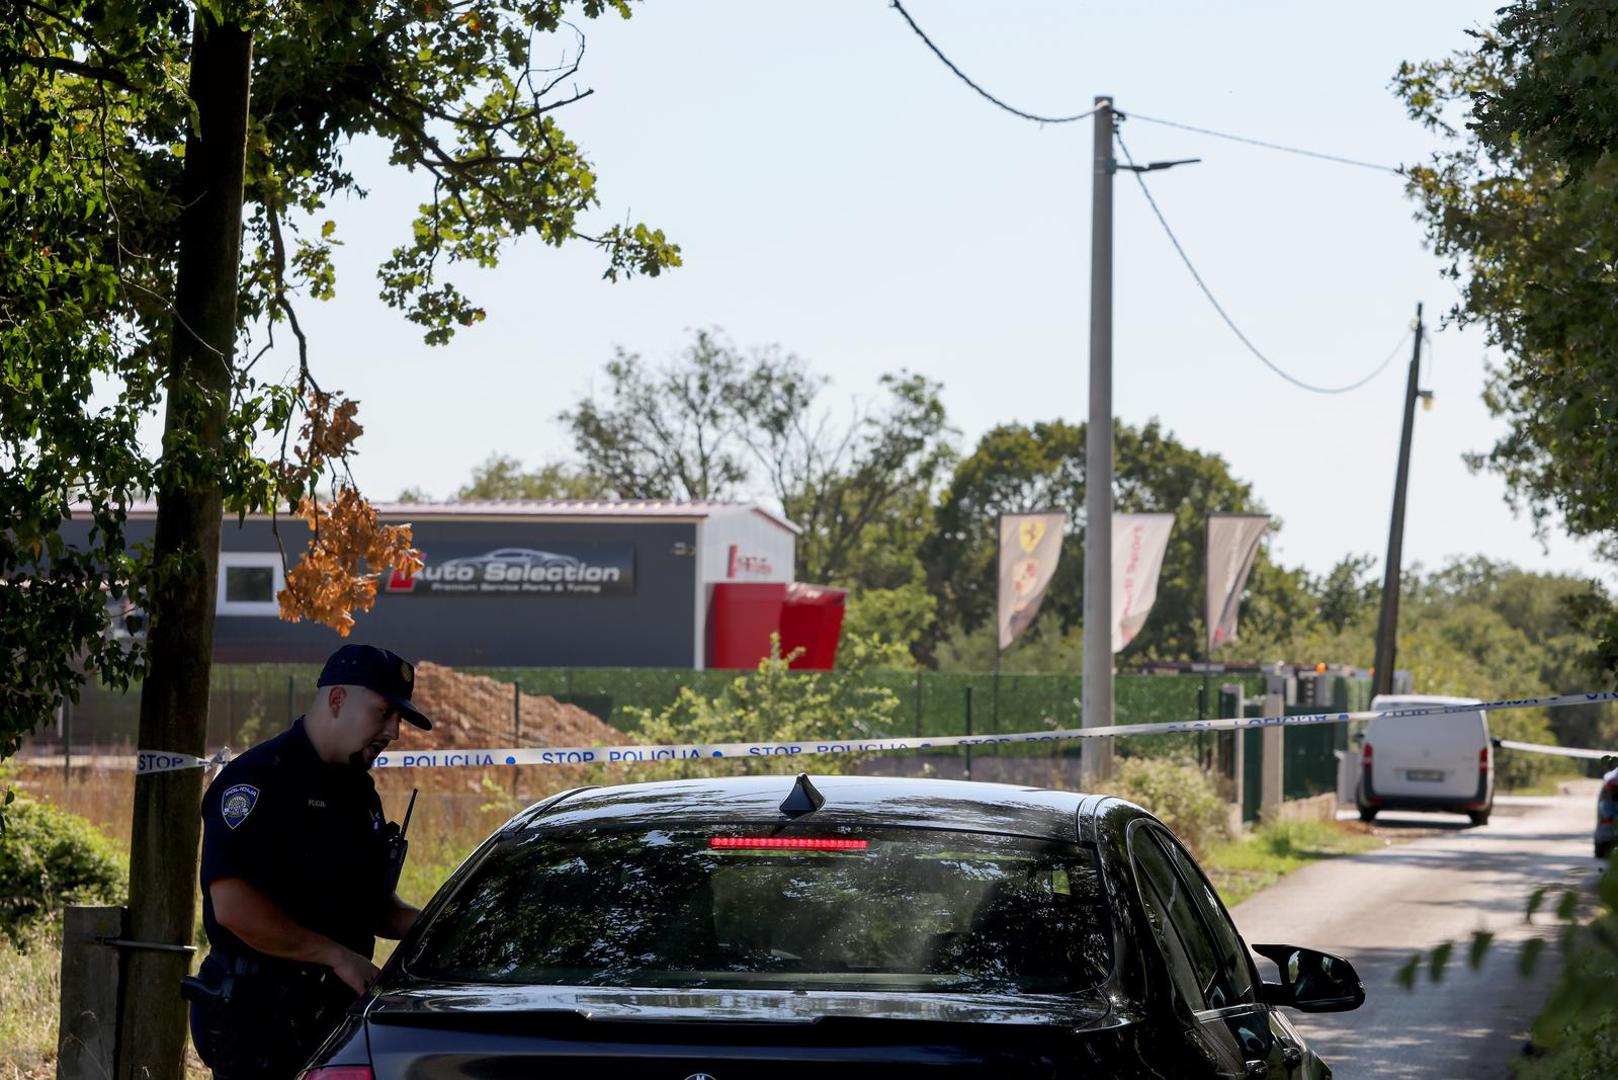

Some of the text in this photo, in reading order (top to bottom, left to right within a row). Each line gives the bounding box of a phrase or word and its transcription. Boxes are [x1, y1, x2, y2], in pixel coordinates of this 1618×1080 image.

[484, 562, 620, 582] Selection
[138, 753, 184, 771] STOP
[542, 751, 595, 764] STOP
